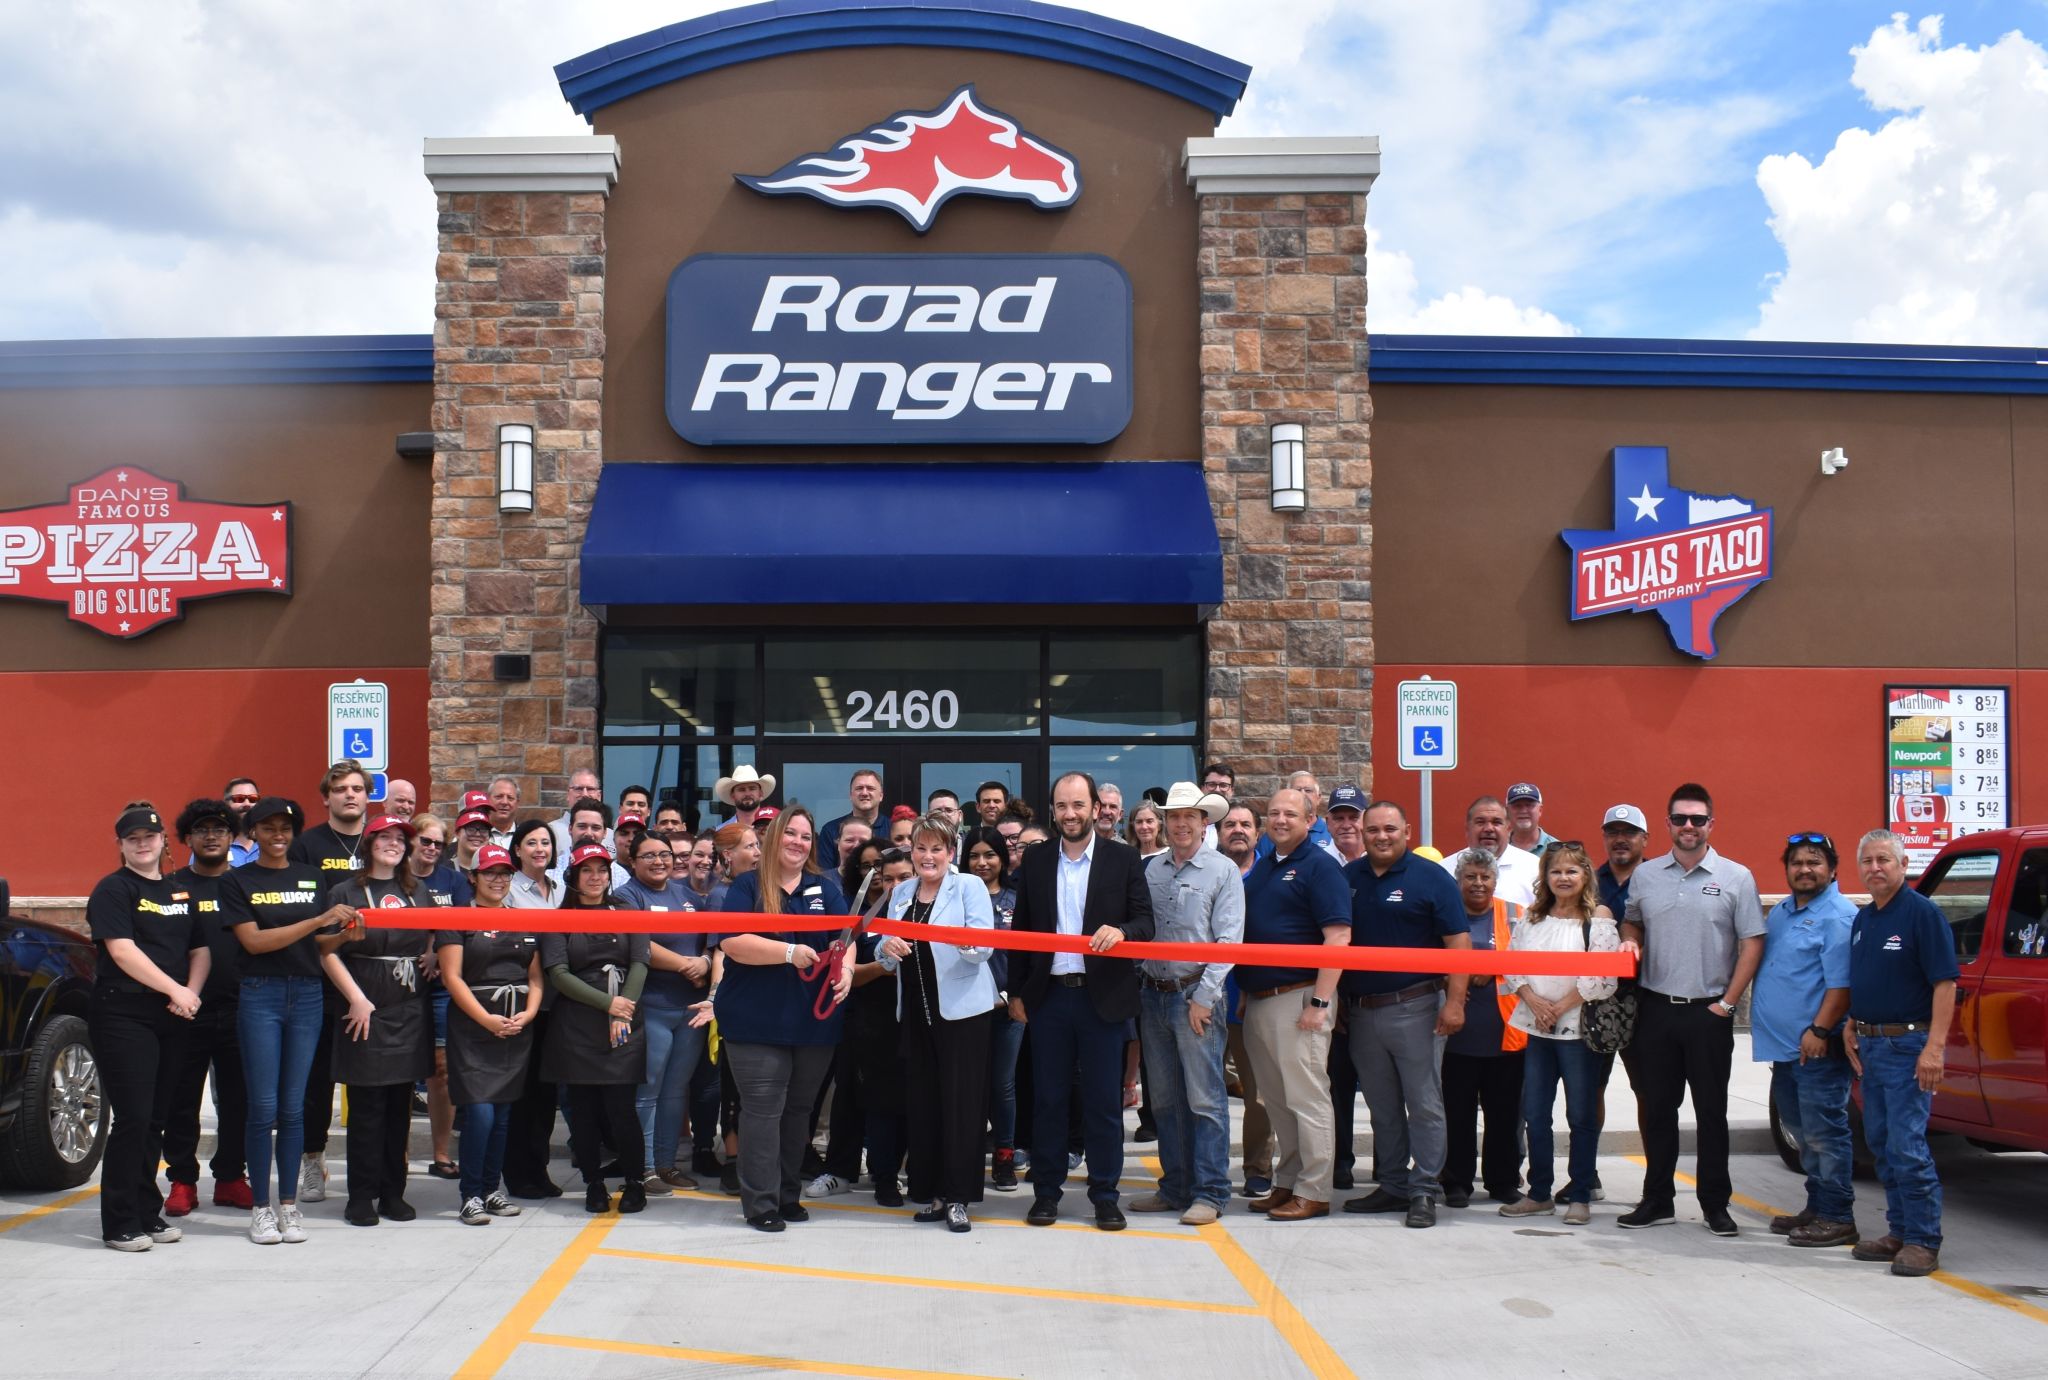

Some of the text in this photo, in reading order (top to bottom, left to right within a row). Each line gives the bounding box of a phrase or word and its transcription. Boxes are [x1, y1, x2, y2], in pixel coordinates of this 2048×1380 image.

[751, 275, 1057, 333] Road
[691, 353, 1112, 420] Ranger
[78, 486, 169, 502] DAN'S
[78, 503, 170, 519] FAMOUS
[0, 521, 269, 584] PIZZA
[1582, 525, 1763, 601] TEJAS TACO
[74, 587, 171, 615] BIG SLICE
[1640, 582, 1703, 604] COMPANY
[333, 692, 383, 704] RESERVED
[1403, 690, 1452, 701] RESERVED
[1897, 690, 1943, 709] Marlboro
[336, 707, 380, 719] PARKING
[846, 689, 959, 730] 2460
[1406, 705, 1449, 716] PARKING
[1895, 750, 1942, 762] Newport
[1898, 833, 1930, 845] inston
[251, 891, 315, 905] SUBWAY
[138, 898, 189, 916] SUBWAY
